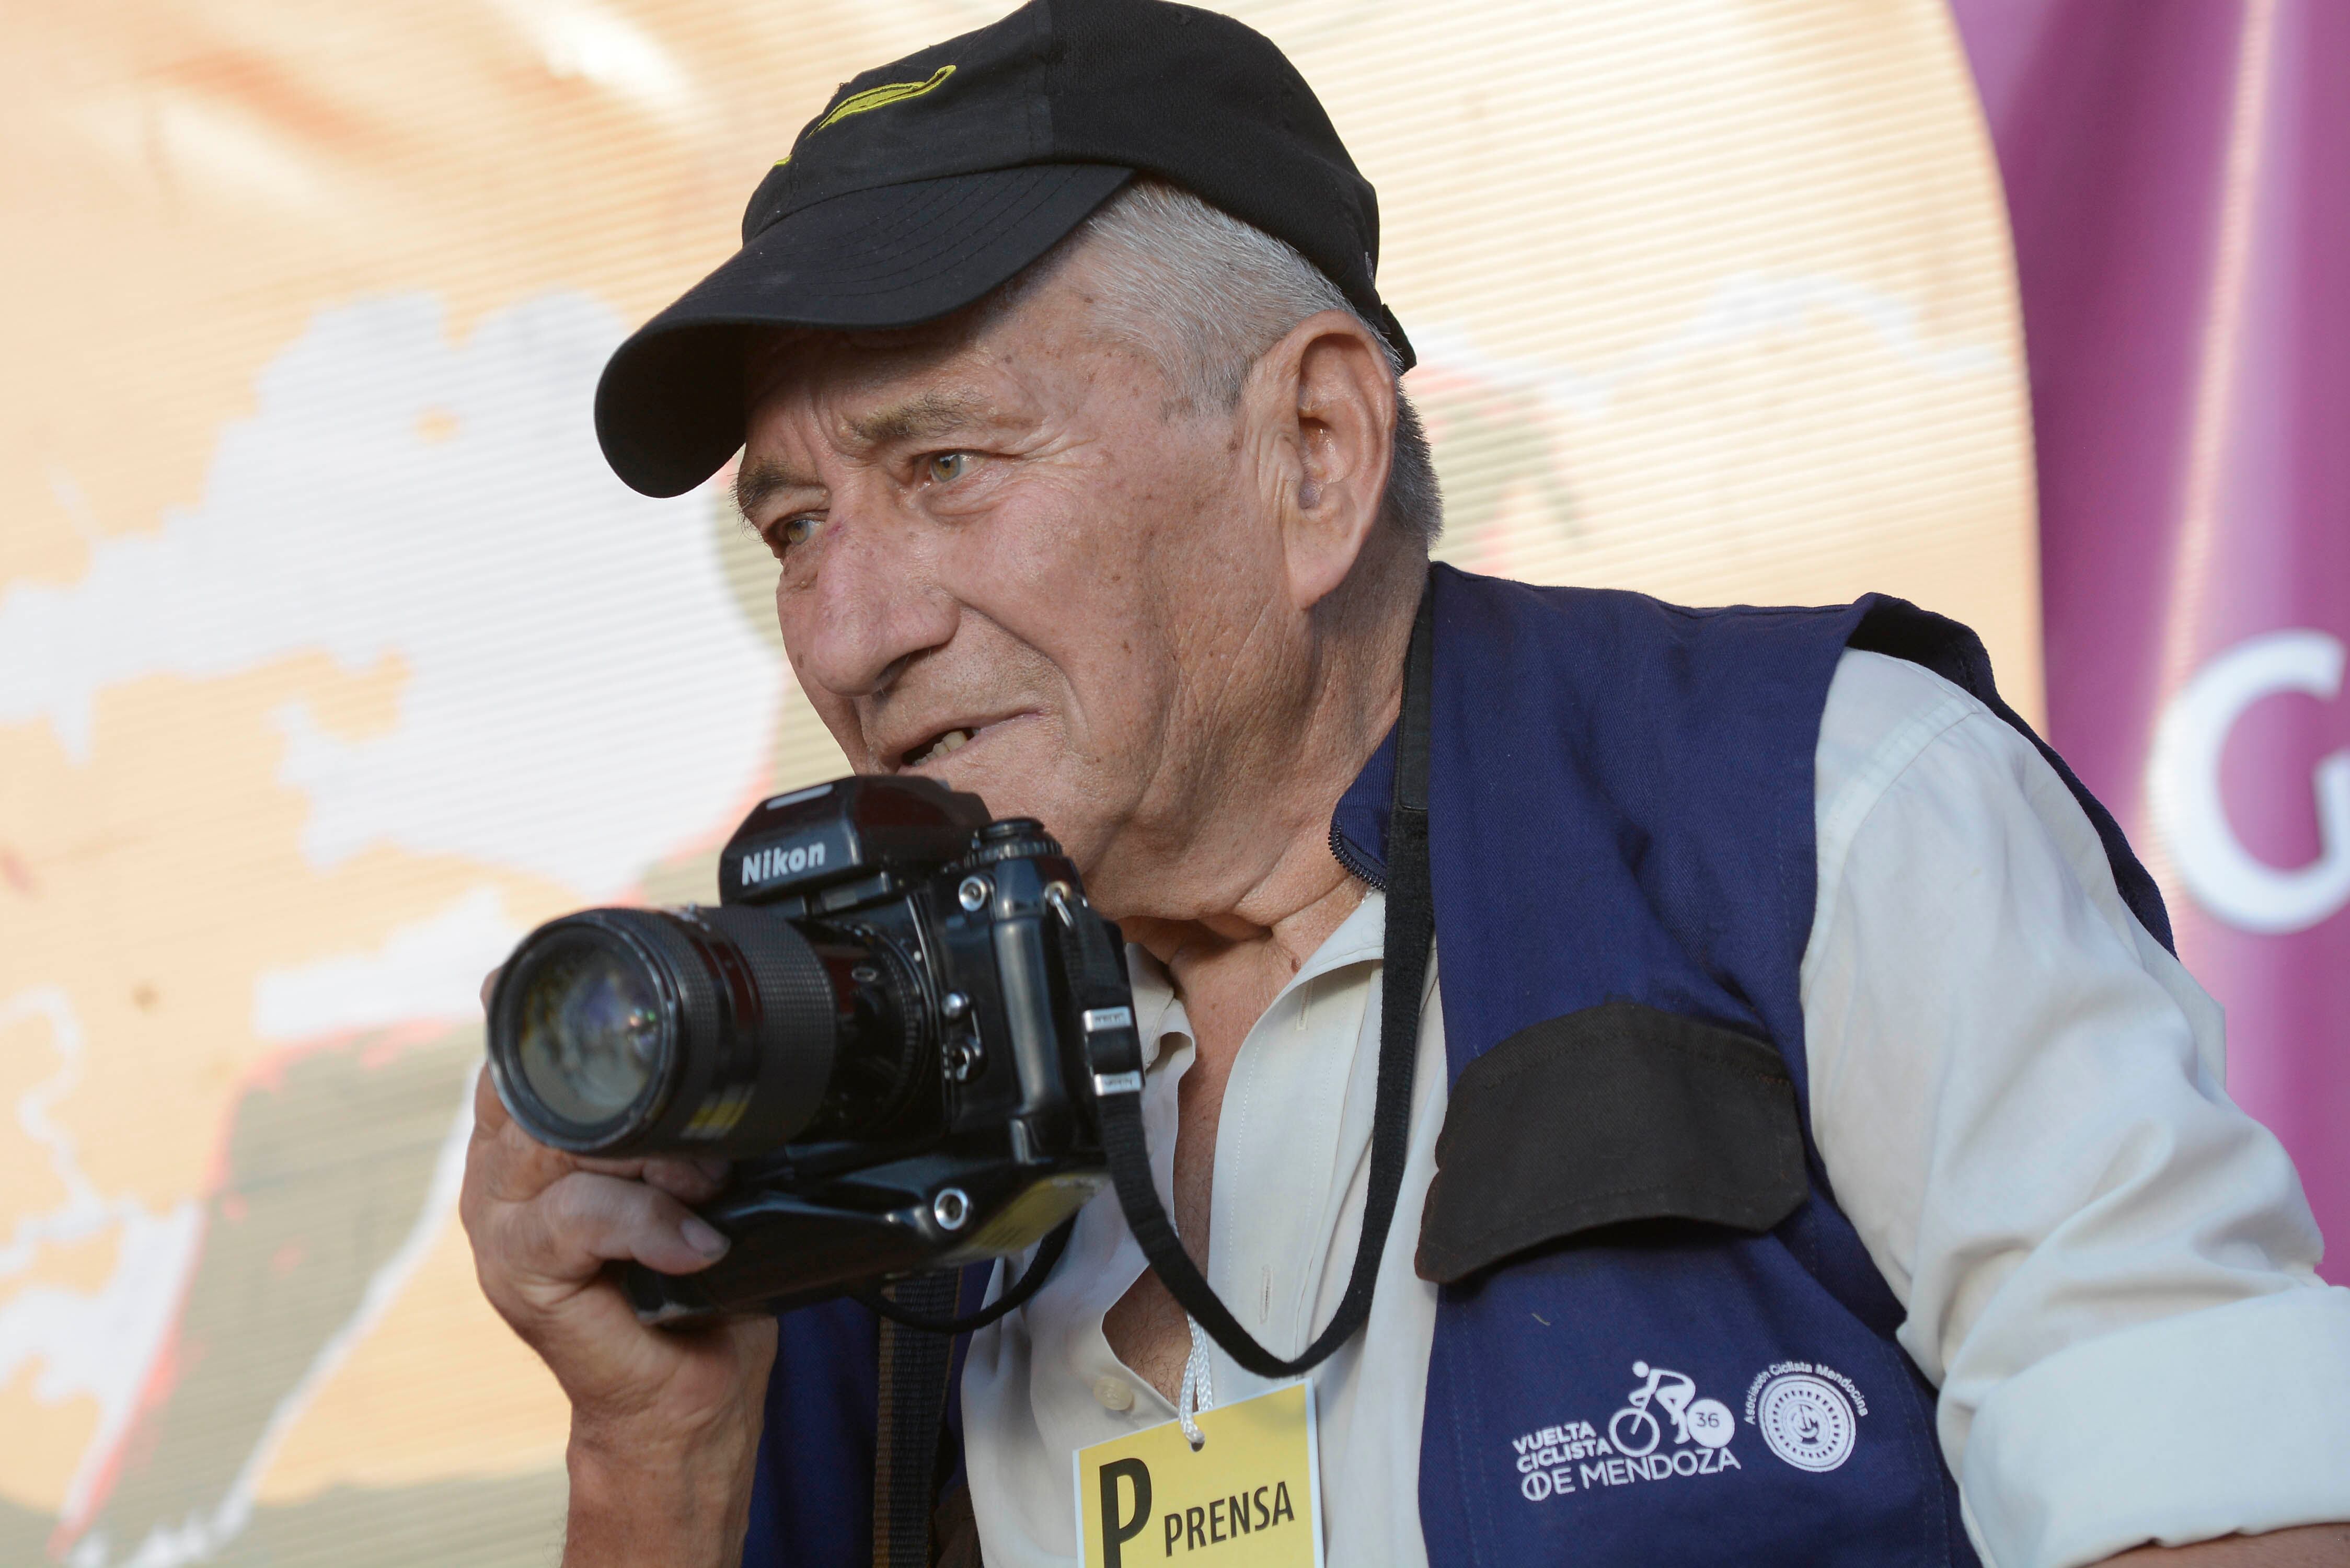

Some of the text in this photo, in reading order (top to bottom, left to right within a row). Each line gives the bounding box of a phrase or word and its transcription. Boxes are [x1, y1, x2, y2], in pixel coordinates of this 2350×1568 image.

[742, 841, 825, 885] Nikon
[1769, 1361, 1812, 1376] Ciclista
[1815, 1362, 1868, 1416] Mendocina
[1512, 1420, 1596, 1455] VUELTA
[1696, 1412, 1720, 1428] 36
[1516, 1436, 1614, 1473] CICLISTA
[1579, 1447, 1741, 1489] MENDOZA
[1099, 1458, 1295, 1568] P PRENSA
